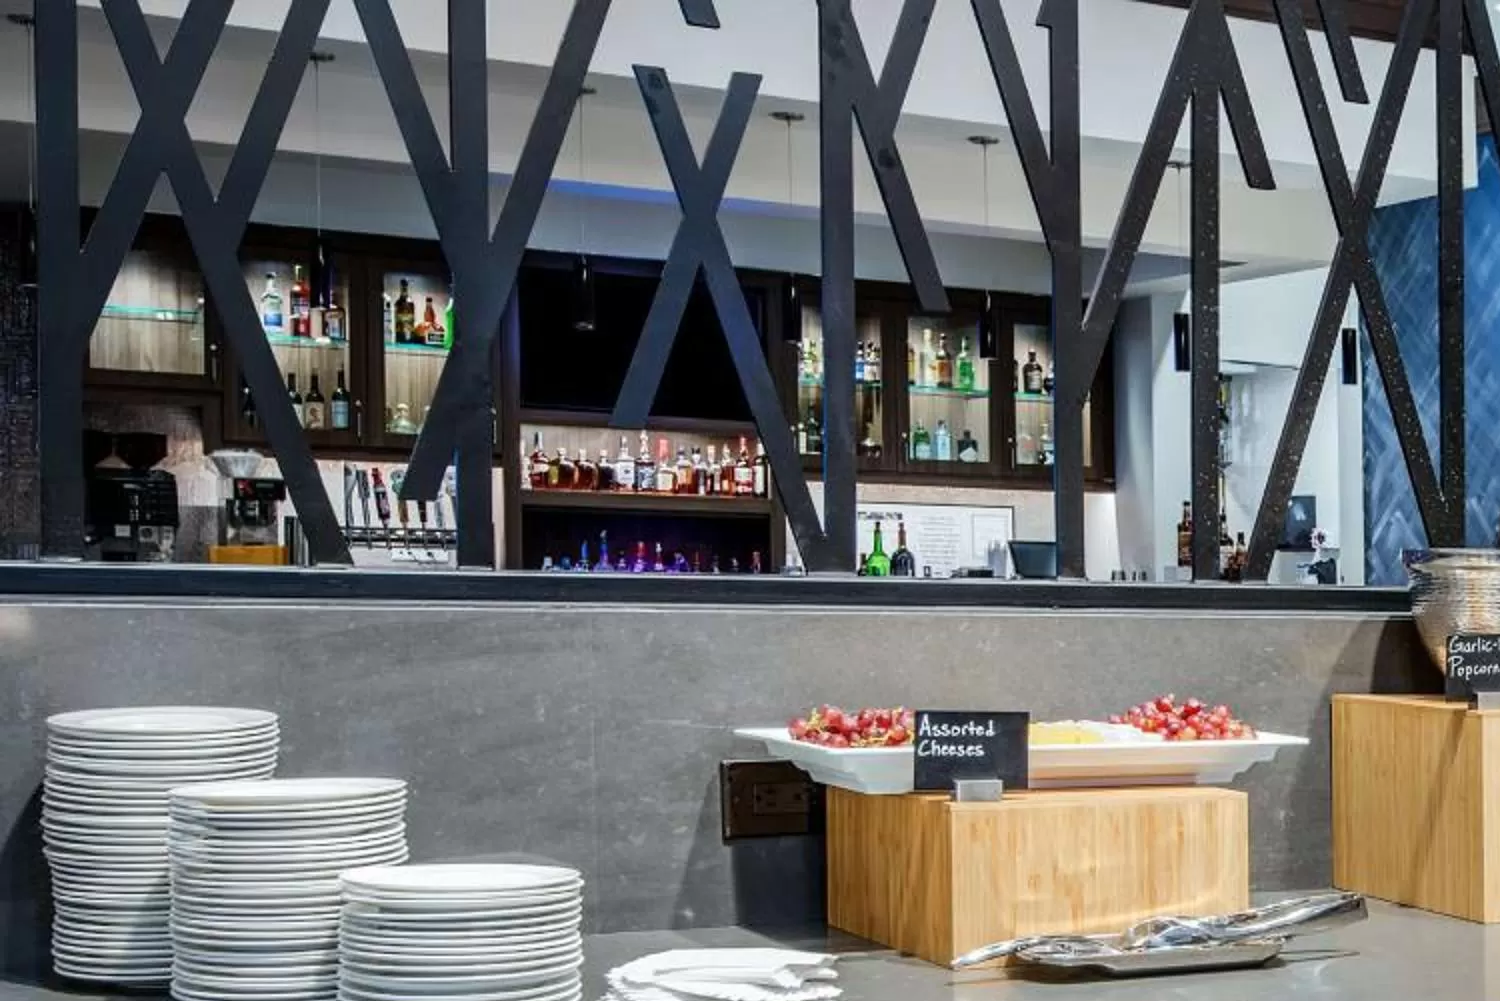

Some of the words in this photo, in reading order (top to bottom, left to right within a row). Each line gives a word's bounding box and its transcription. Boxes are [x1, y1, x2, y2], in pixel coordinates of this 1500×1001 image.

[1447, 656, 1500, 680] Popcorn
[918, 713, 996, 737] Assorted
[917, 739, 985, 757] Cheeses
